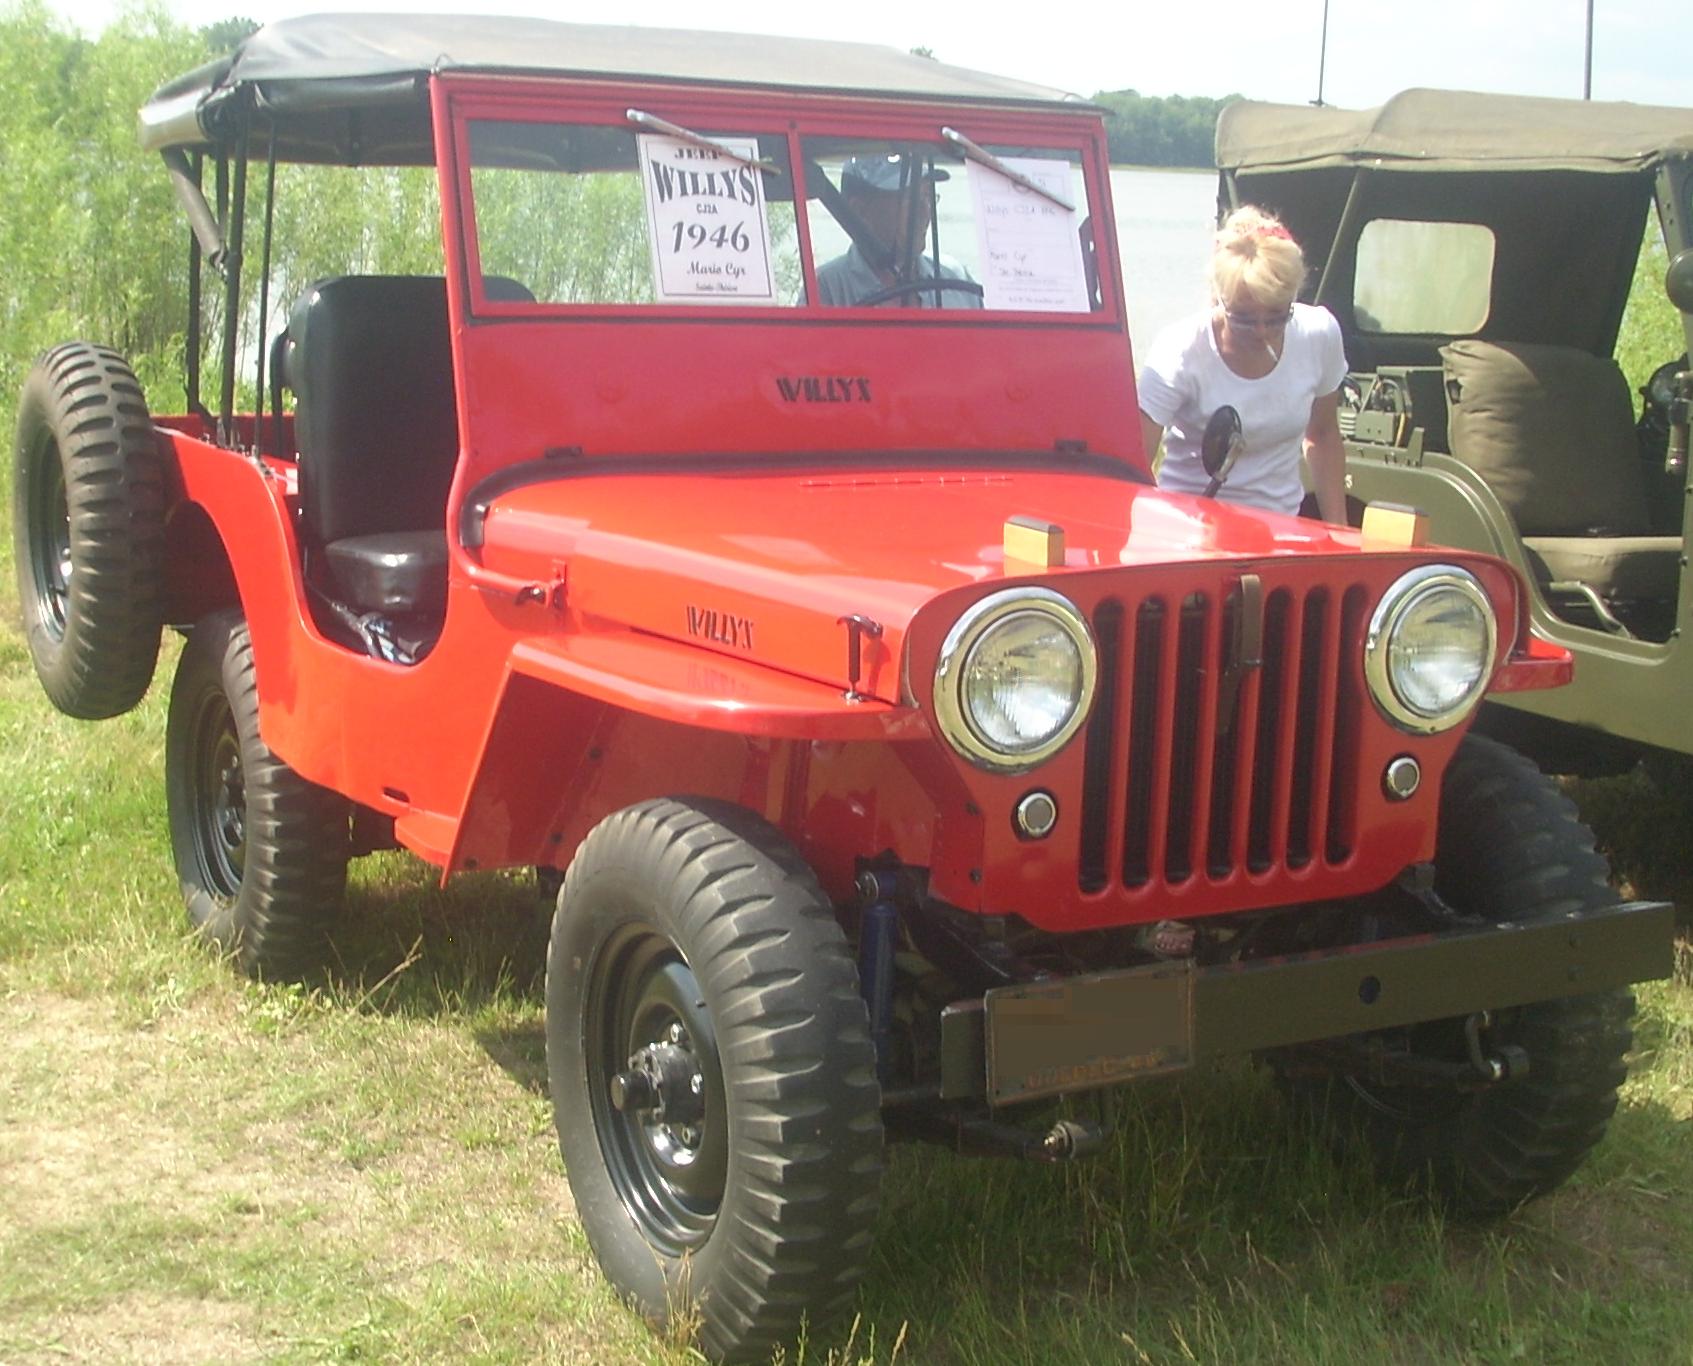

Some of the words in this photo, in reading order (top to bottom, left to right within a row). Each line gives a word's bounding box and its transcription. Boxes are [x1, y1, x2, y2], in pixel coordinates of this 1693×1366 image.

[651, 160, 756, 206] WILLYS
[673, 221, 750, 254] 1946
[687, 260, 722, 275] Mario
[725, 261, 746, 279] Cyr
[775, 377, 871, 402] WILLYS
[686, 605, 754, 650] WILLYS
